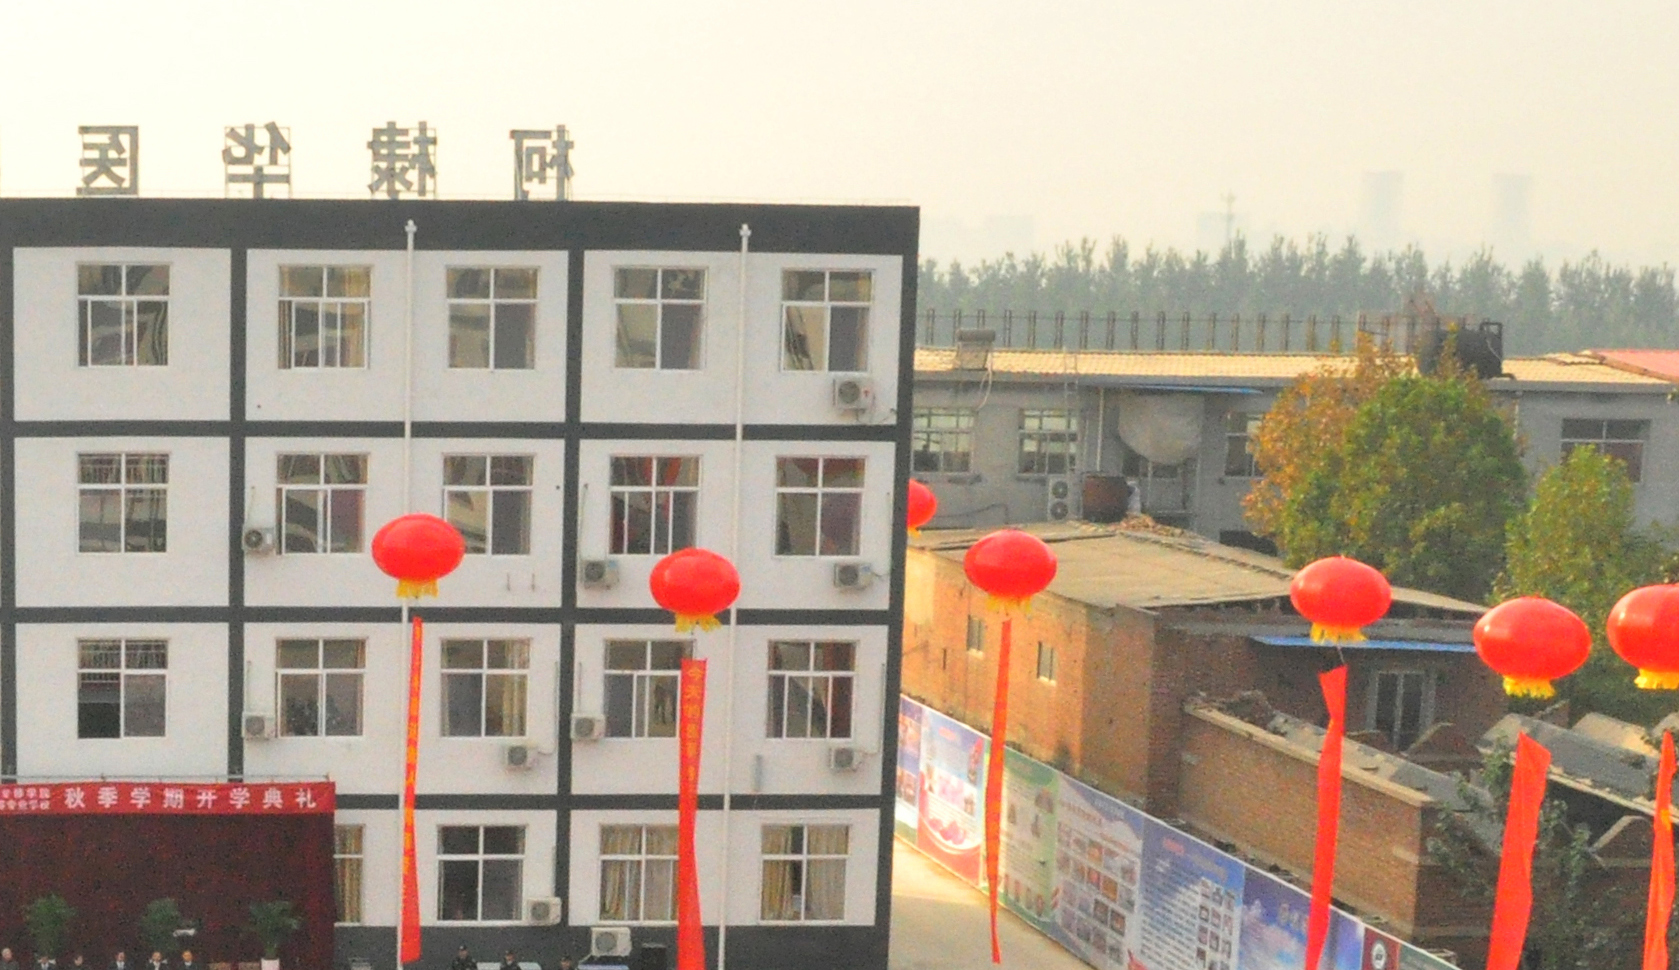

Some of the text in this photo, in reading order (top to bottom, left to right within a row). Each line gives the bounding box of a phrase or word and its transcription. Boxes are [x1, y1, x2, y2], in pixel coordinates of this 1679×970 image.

[63, 786, 317, 810] 秋季学期开学典礼
